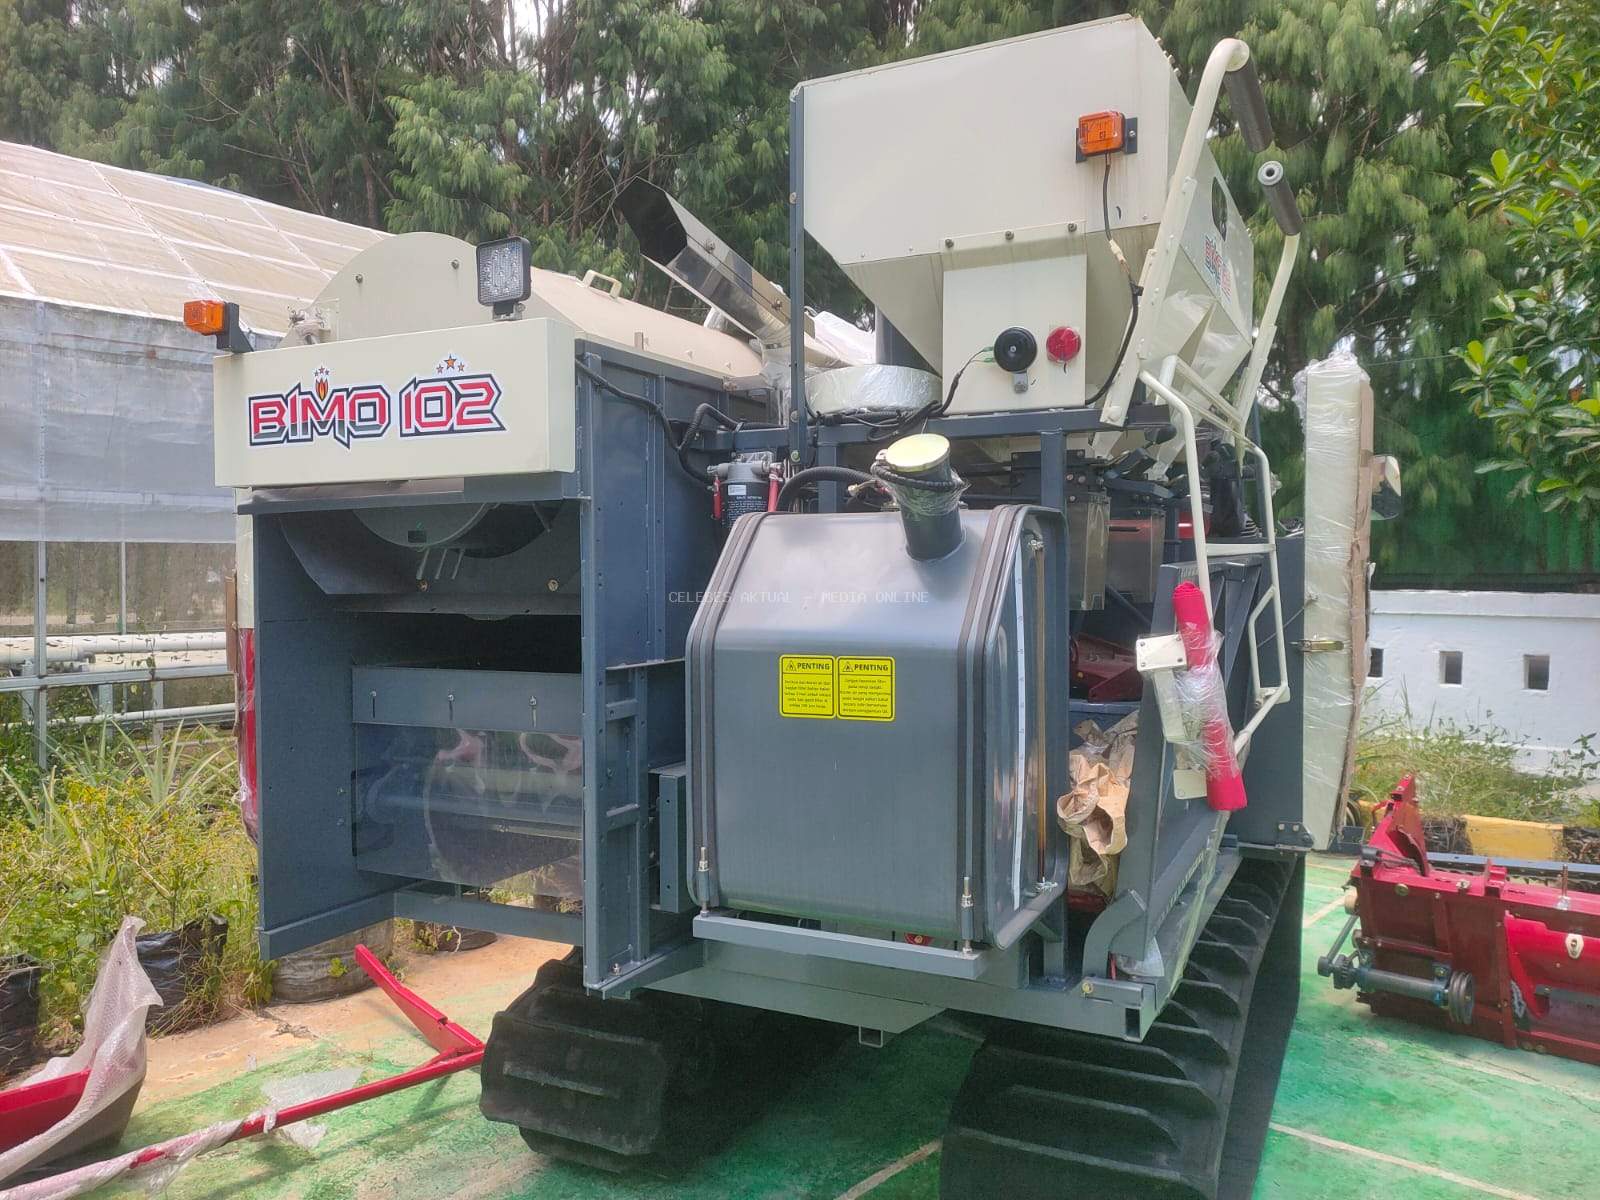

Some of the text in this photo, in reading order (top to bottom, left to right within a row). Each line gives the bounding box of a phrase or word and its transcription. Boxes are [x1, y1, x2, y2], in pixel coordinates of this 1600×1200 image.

[248, 374, 506, 450] BIMO 102
[797, 662, 831, 670] PENTING
[854, 663, 889, 671] PENTING
